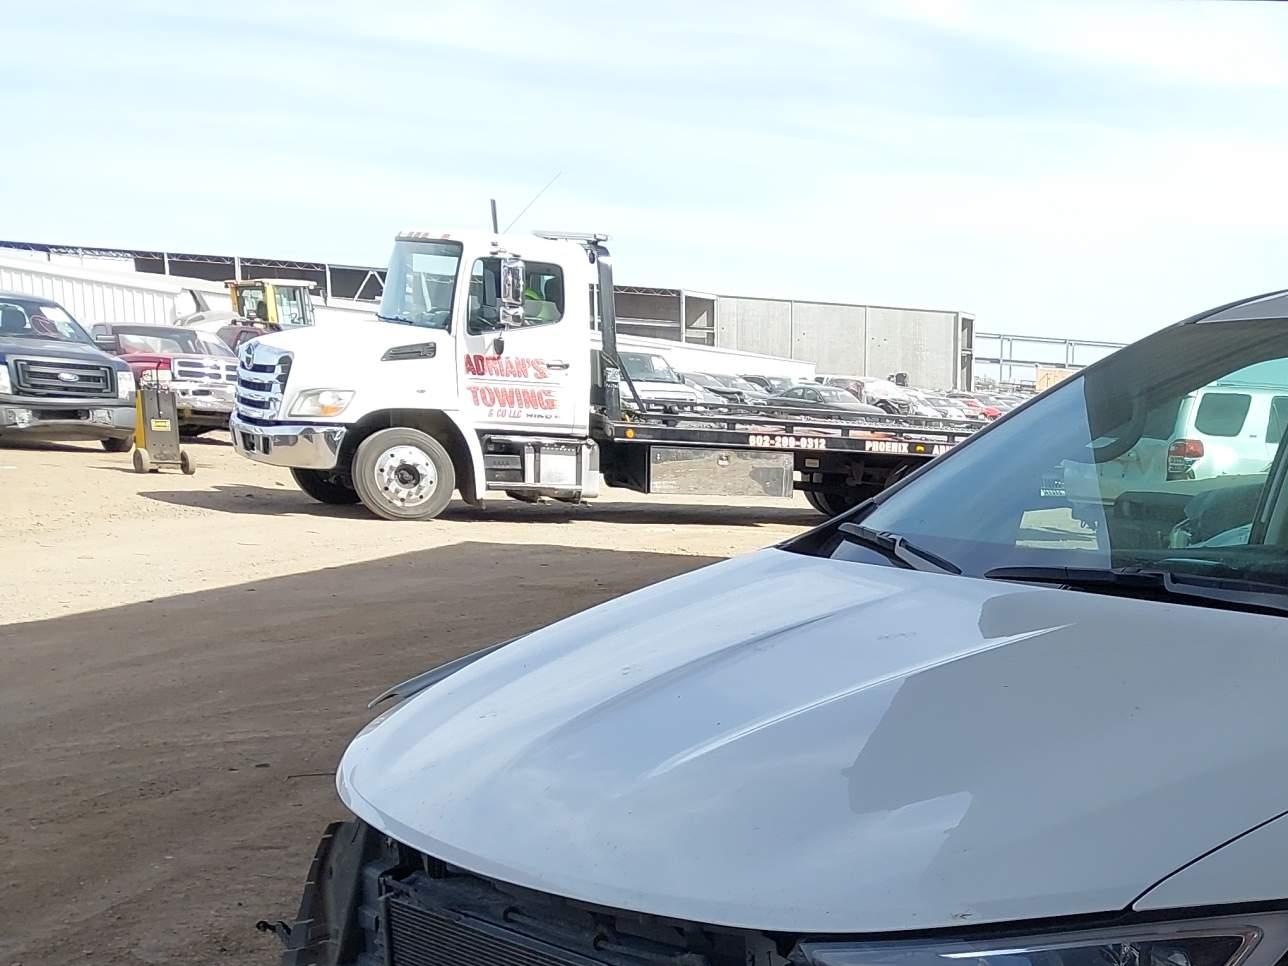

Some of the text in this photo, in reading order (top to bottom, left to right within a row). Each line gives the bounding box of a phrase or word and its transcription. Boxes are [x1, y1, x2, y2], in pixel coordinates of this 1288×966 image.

[463, 353, 548, 380] ADRIAN'S
[466, 384, 558, 410] TOWING
[865, 440, 909, 453] PHOENIX
